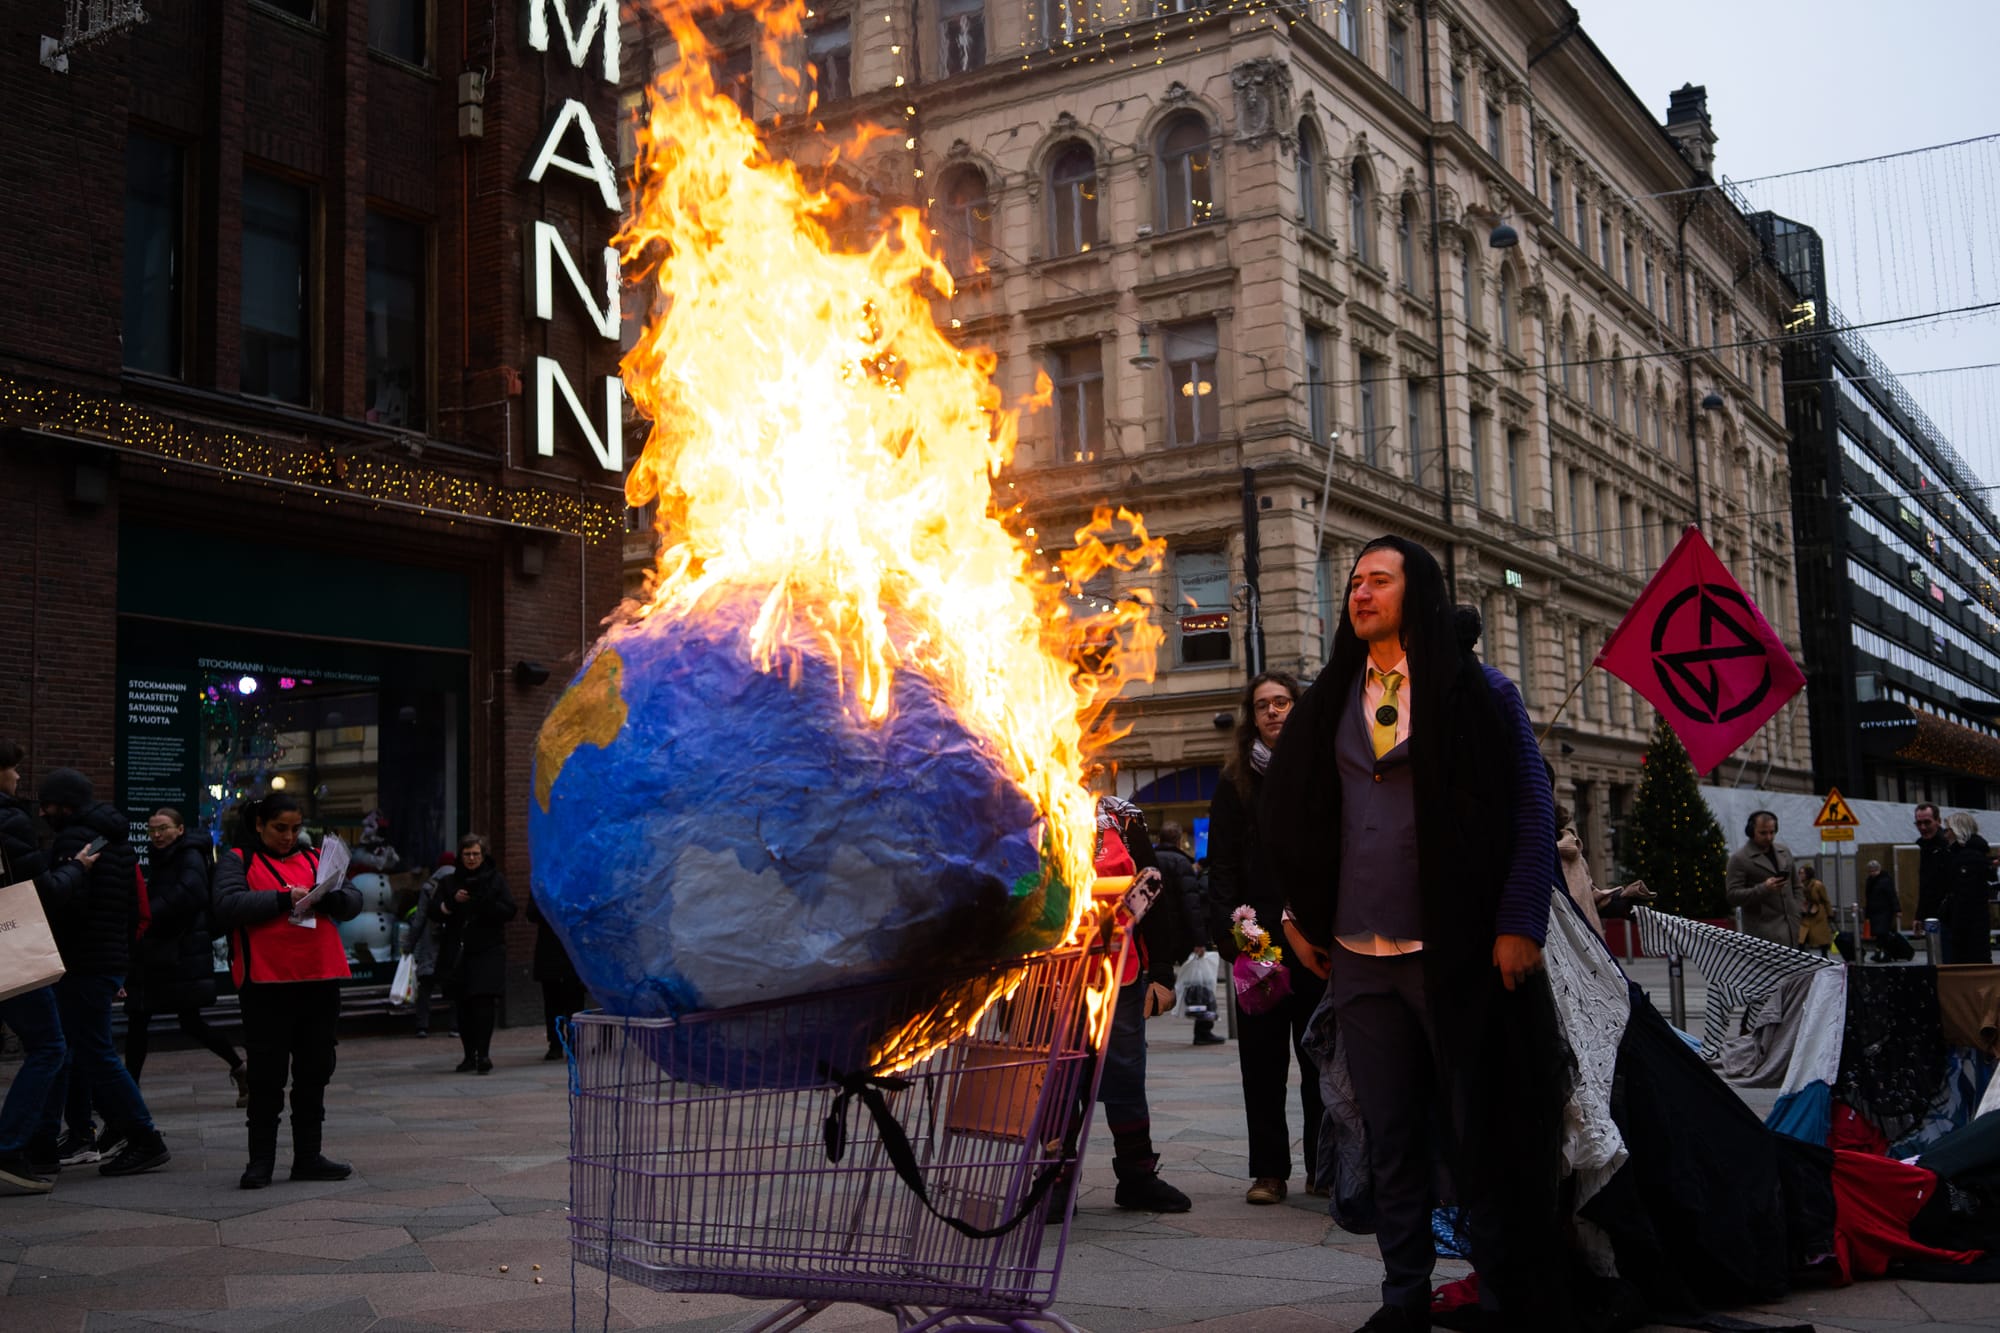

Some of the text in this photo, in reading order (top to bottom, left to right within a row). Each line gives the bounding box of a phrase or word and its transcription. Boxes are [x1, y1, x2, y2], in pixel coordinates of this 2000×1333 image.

[197, 657, 264, 672] STOCKMANN
[308, 668, 322, 678] och
[323, 670, 380, 681] stockmann.com
[128, 679, 187, 692] STOCKMANNIN
[128, 691, 179, 703] RAKASTETTU
[128, 703, 179, 714] SATUIKKUNA
[128, 714, 170, 725] 75 VUOTTA
[1860, 718, 1918, 729] CITYCENTER
